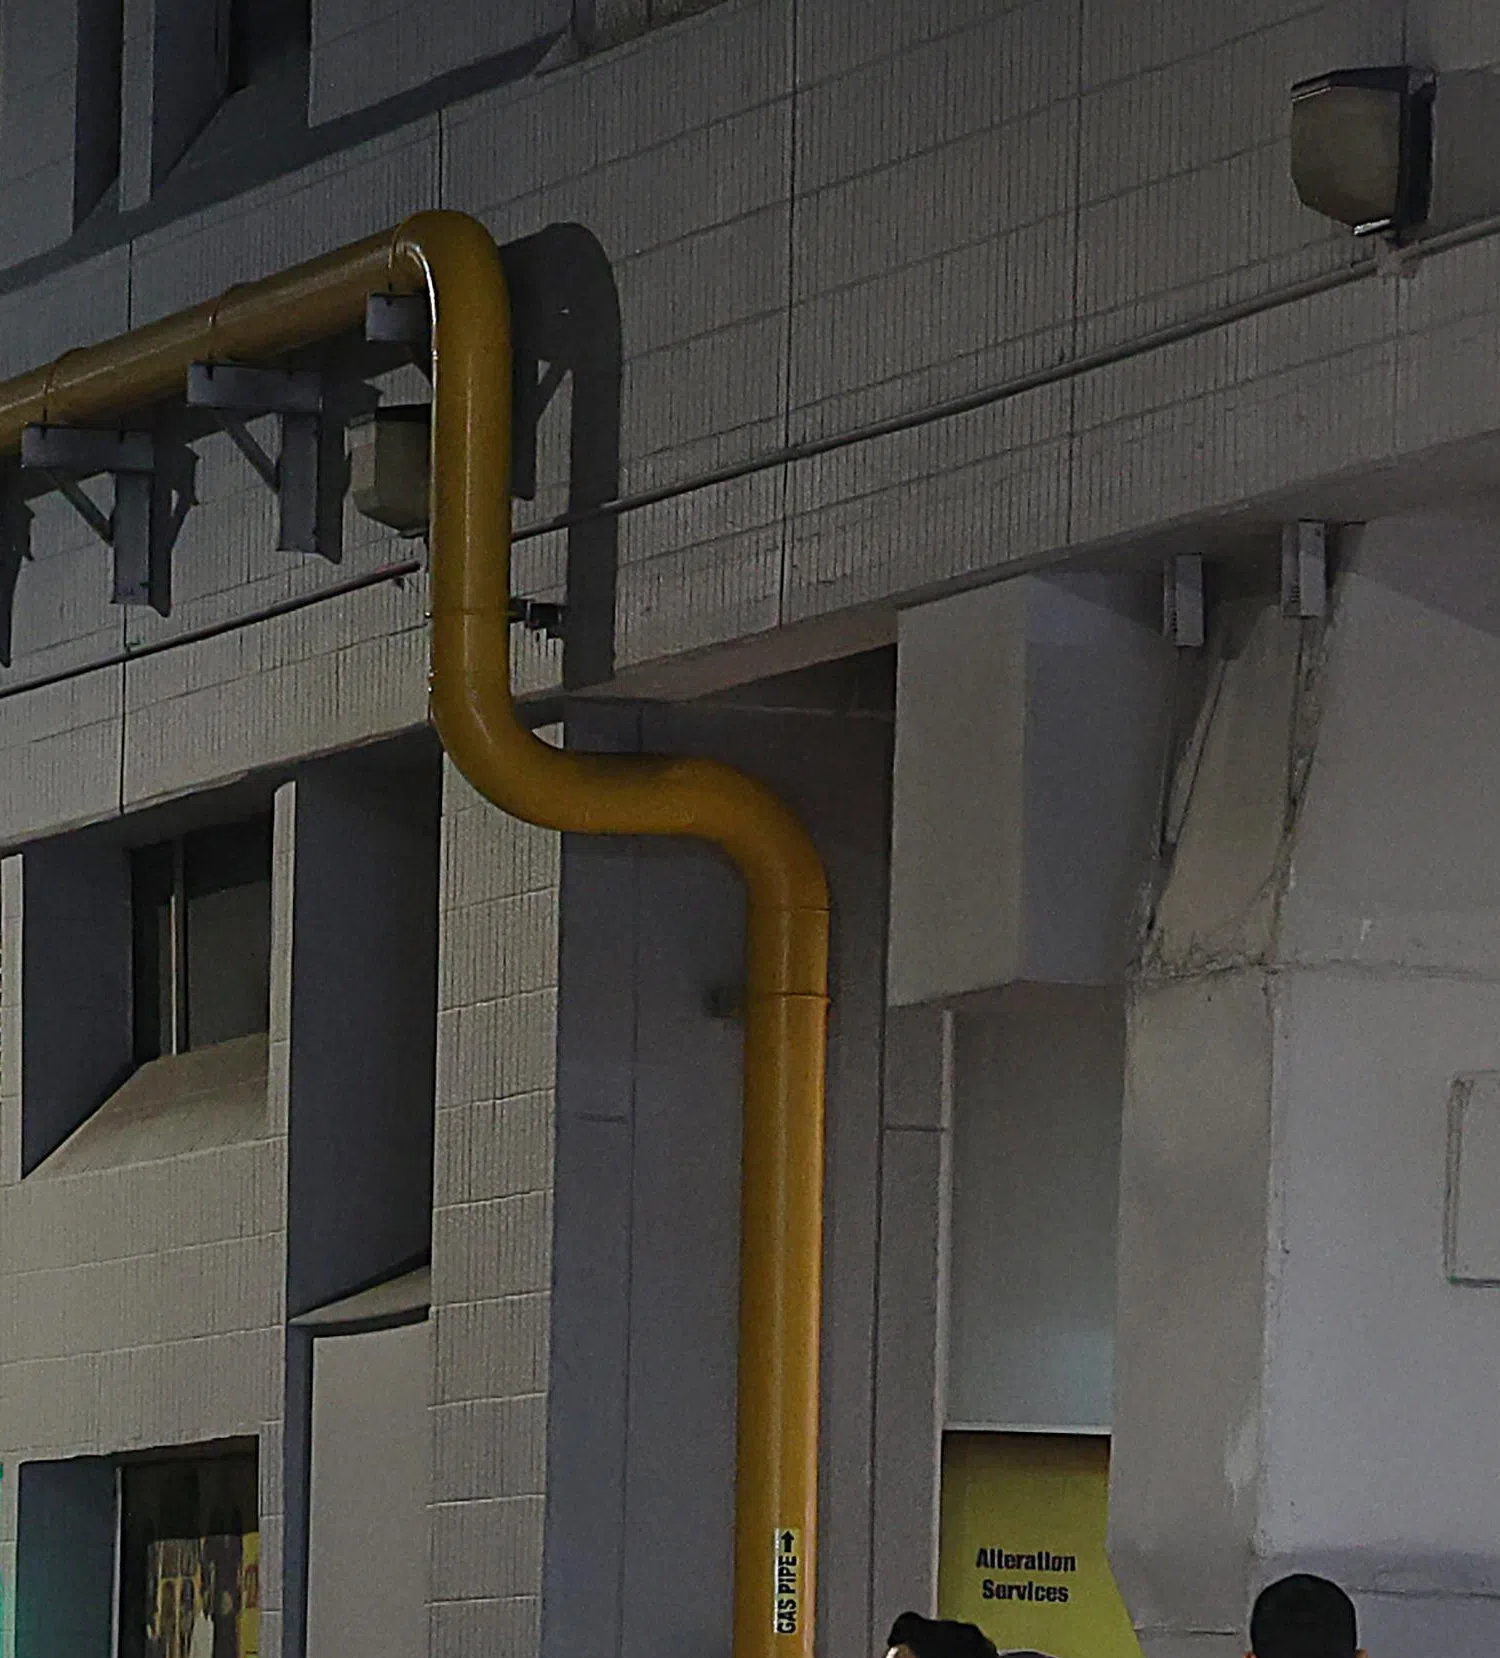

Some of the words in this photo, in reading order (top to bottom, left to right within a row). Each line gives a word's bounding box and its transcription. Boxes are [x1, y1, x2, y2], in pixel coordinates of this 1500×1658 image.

[778, 1555, 798, 1595] PIPE
[975, 1548, 1077, 1573] Alteration
[981, 1578, 1070, 1603] Services
[776, 1598, 797, 1635] GAS
